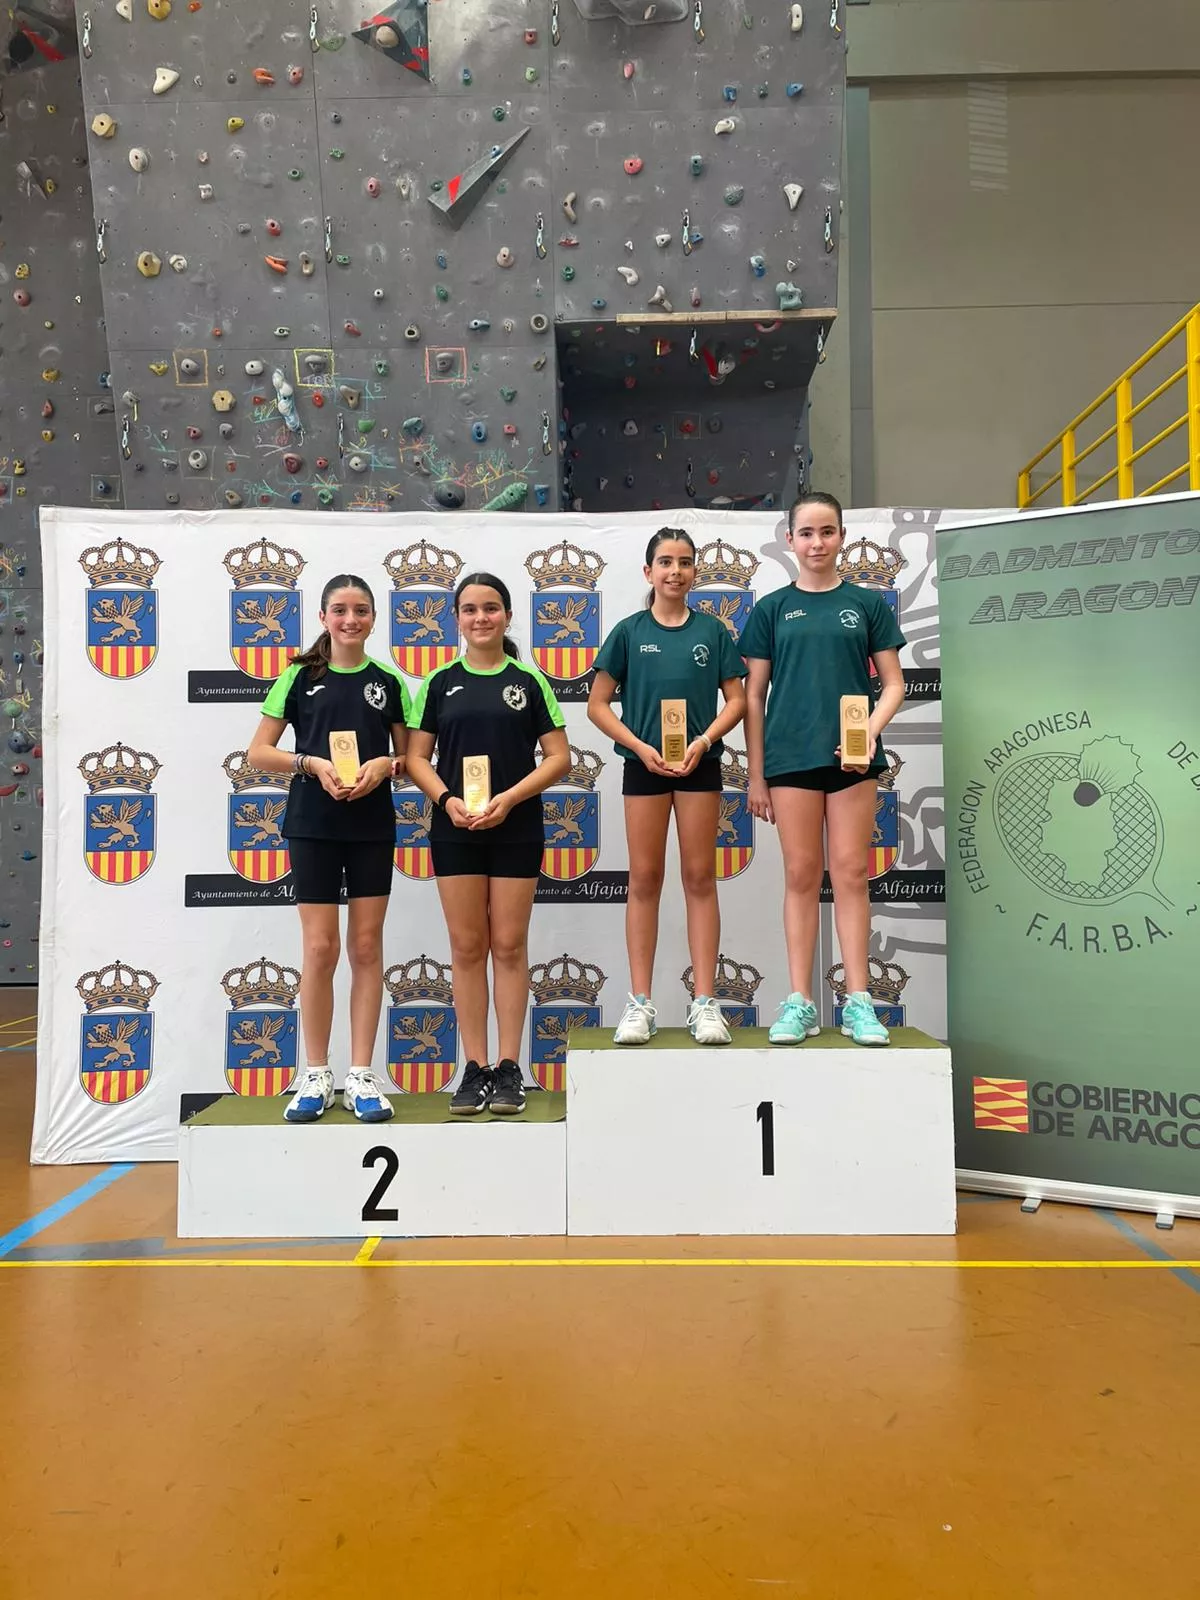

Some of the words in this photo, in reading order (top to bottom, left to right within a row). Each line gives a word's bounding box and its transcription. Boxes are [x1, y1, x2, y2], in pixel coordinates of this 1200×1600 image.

[940, 528, 1200, 582] BADMINTO
[784, 609, 807, 621] RSL
[969, 575, 1200, 624] ARAGON
[639, 644, 662, 653] RSL
[195, 686, 261, 697] Ayuntamiento
[958, 780, 990, 894] FEDERACION
[983, 710, 1092, 774] ARAGONESA
[1167, 740, 1200, 770] DE
[192, 890, 258, 900] Ayuntamiento
[261, 889, 271, 898] de
[562, 886, 572, 895] de
[1026, 912, 1174, 954] F.A.R.B.A.
[1031, 1081, 1200, 1120] GOBIERNO
[757, 1101, 775, 1176] 1
[1033, 1110, 1075, 1138] DE
[361, 1145, 400, 1222] 2
